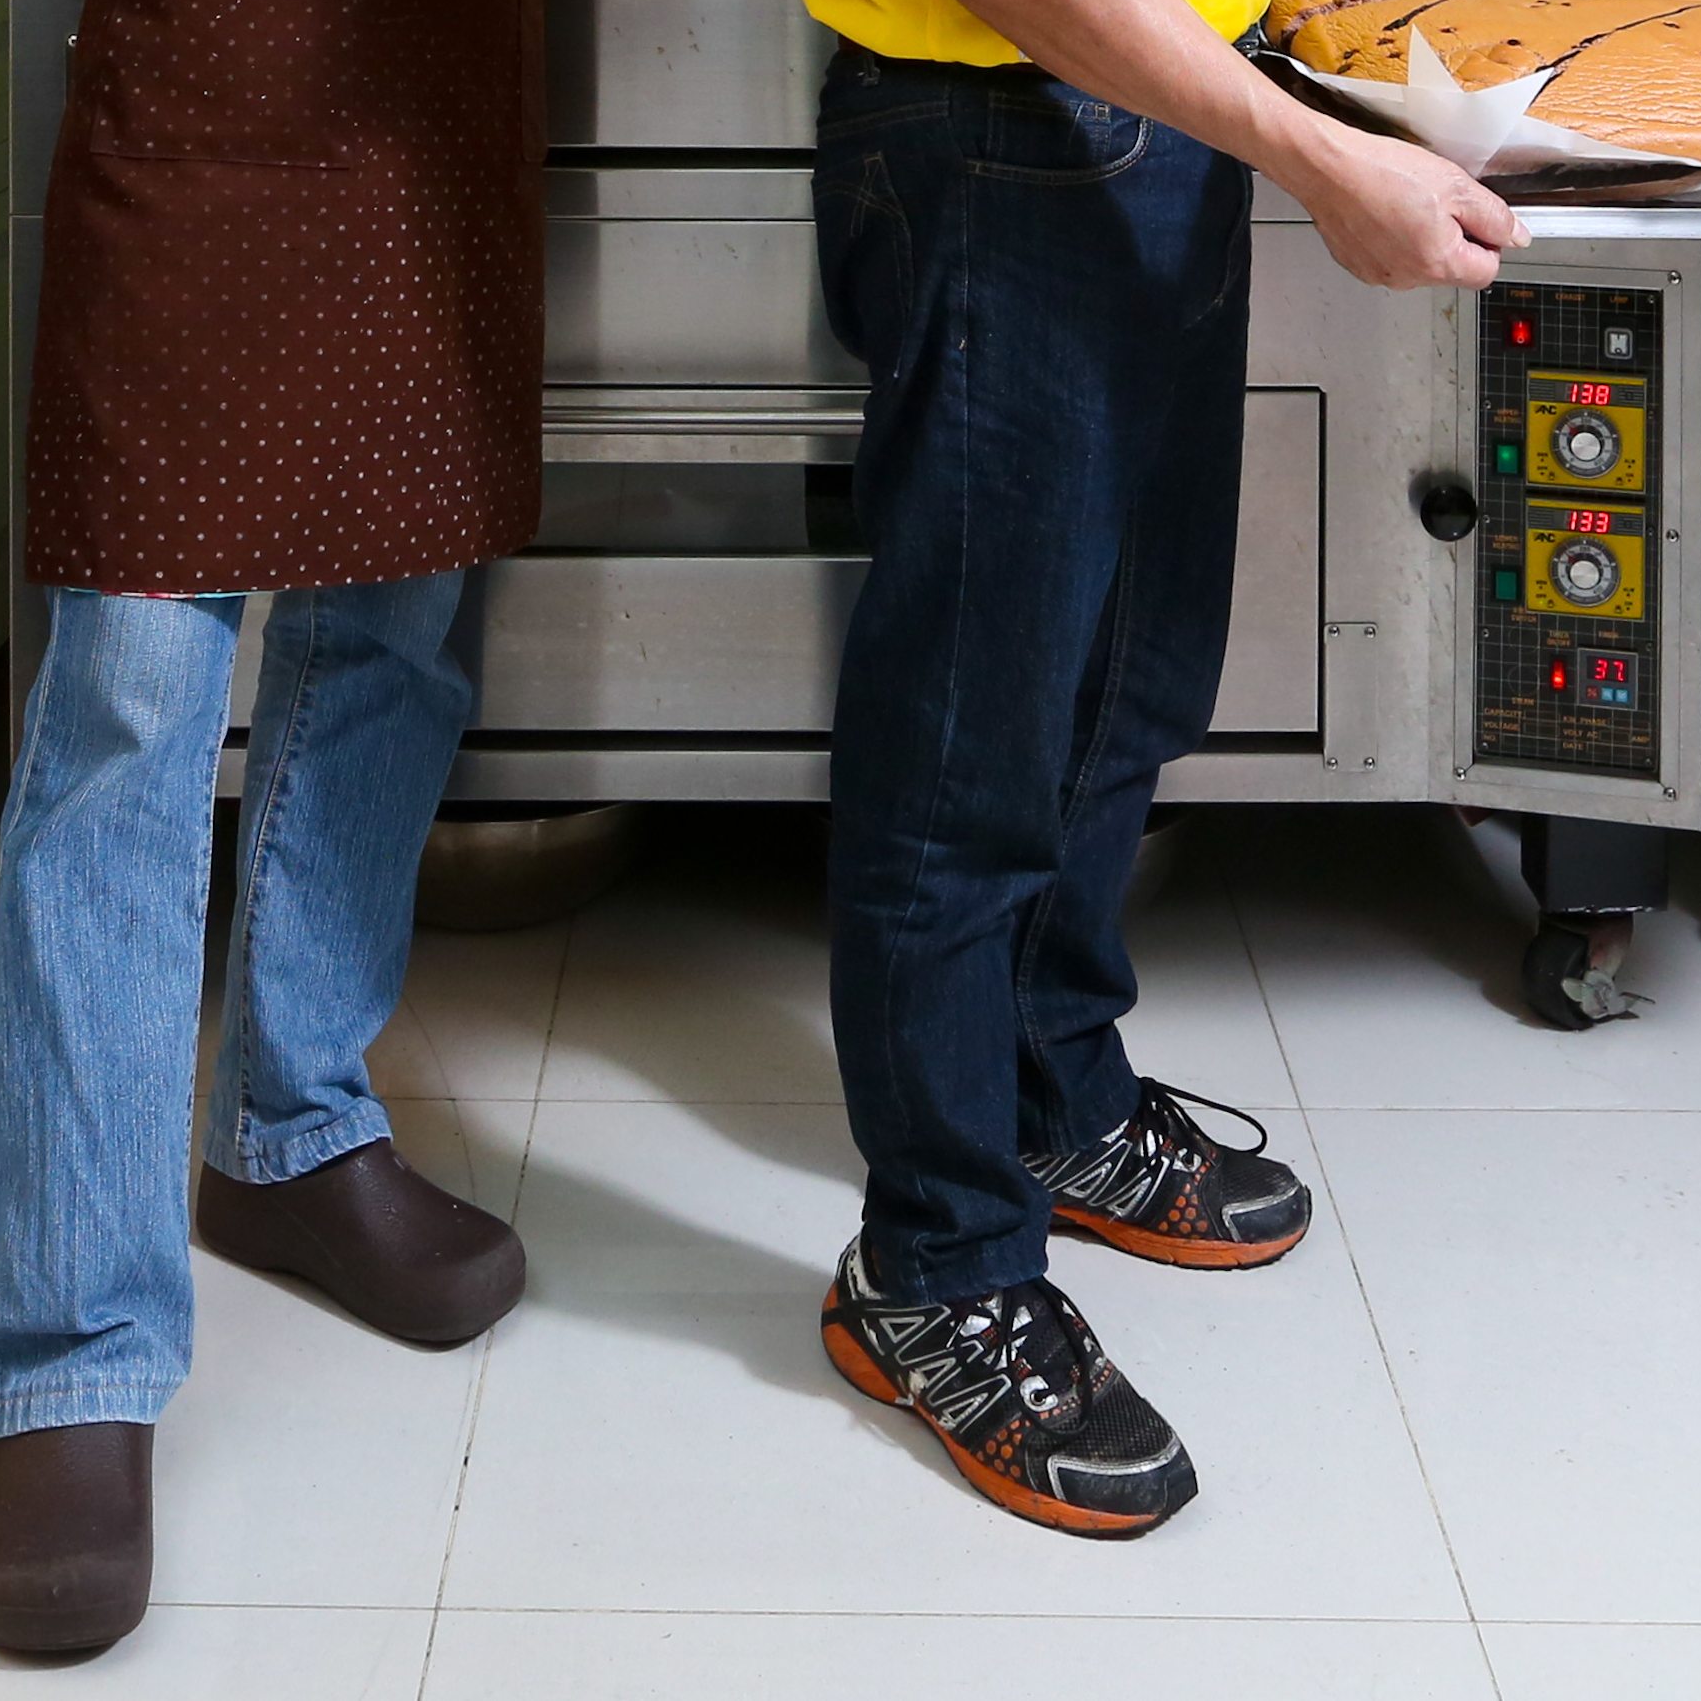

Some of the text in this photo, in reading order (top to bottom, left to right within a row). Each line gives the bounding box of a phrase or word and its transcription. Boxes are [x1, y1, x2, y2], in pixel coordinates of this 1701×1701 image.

[1570, 383, 1611, 405] 138
[1535, 405, 1557, 415] ANC
[1570, 510, 1611, 533] 133
[1534, 533, 1556, 543] ANC
[1594, 659, 1625, 681] 37
